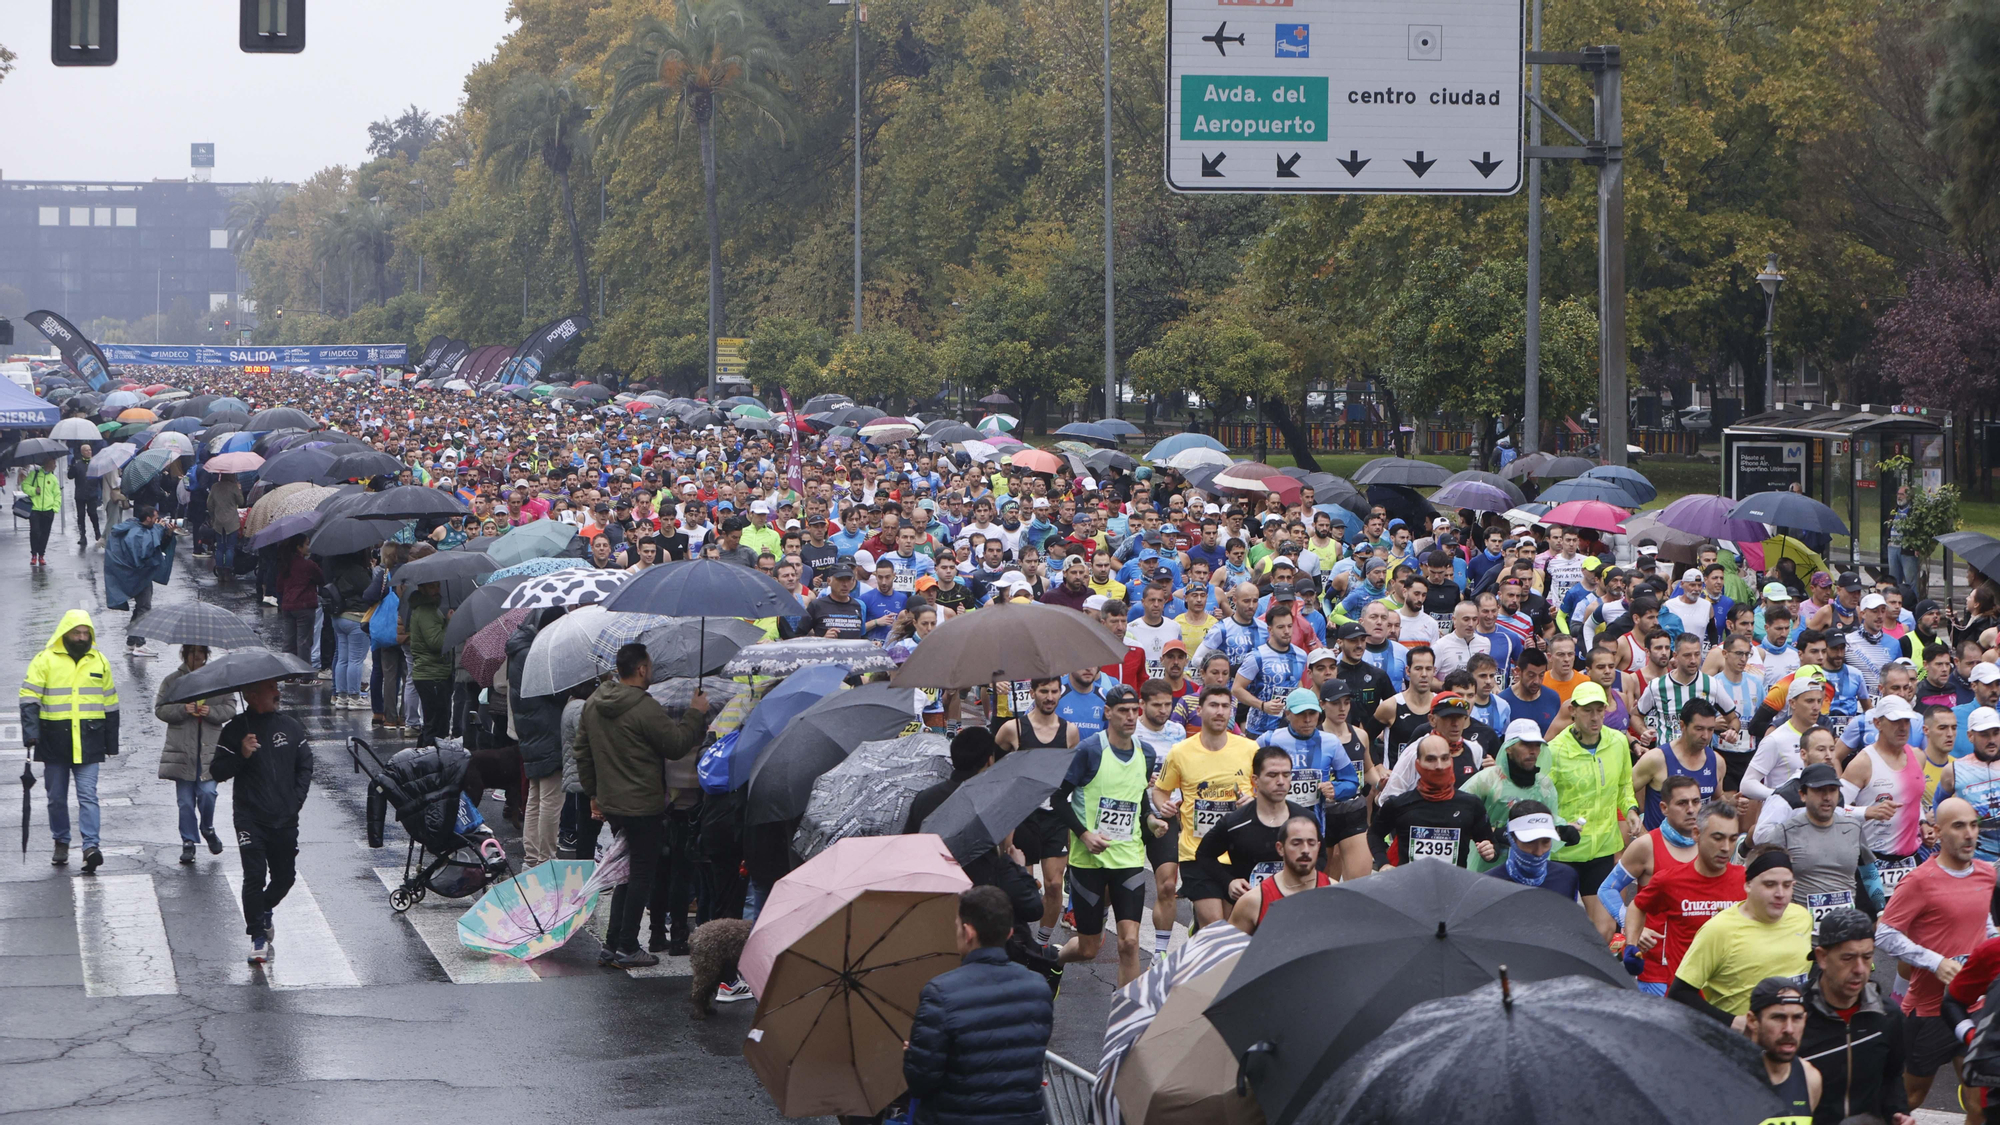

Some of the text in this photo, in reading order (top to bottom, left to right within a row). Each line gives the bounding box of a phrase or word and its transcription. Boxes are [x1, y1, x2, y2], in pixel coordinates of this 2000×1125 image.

[1204, 84, 1306, 102] Avda. del
[1348, 87, 1500, 106] centro ciudad
[1194, 115, 1315, 137] Aeropuerto
[546, 319, 573, 342] POWER
[561, 324, 578, 339] ADE
[230, 351, 277, 361] SALIDA
[812, 556, 835, 568] FALCÓN
[894, 575, 913, 583] 2381
[1101, 811, 1131, 826] 2273
[1415, 841, 1452, 856] 2395
